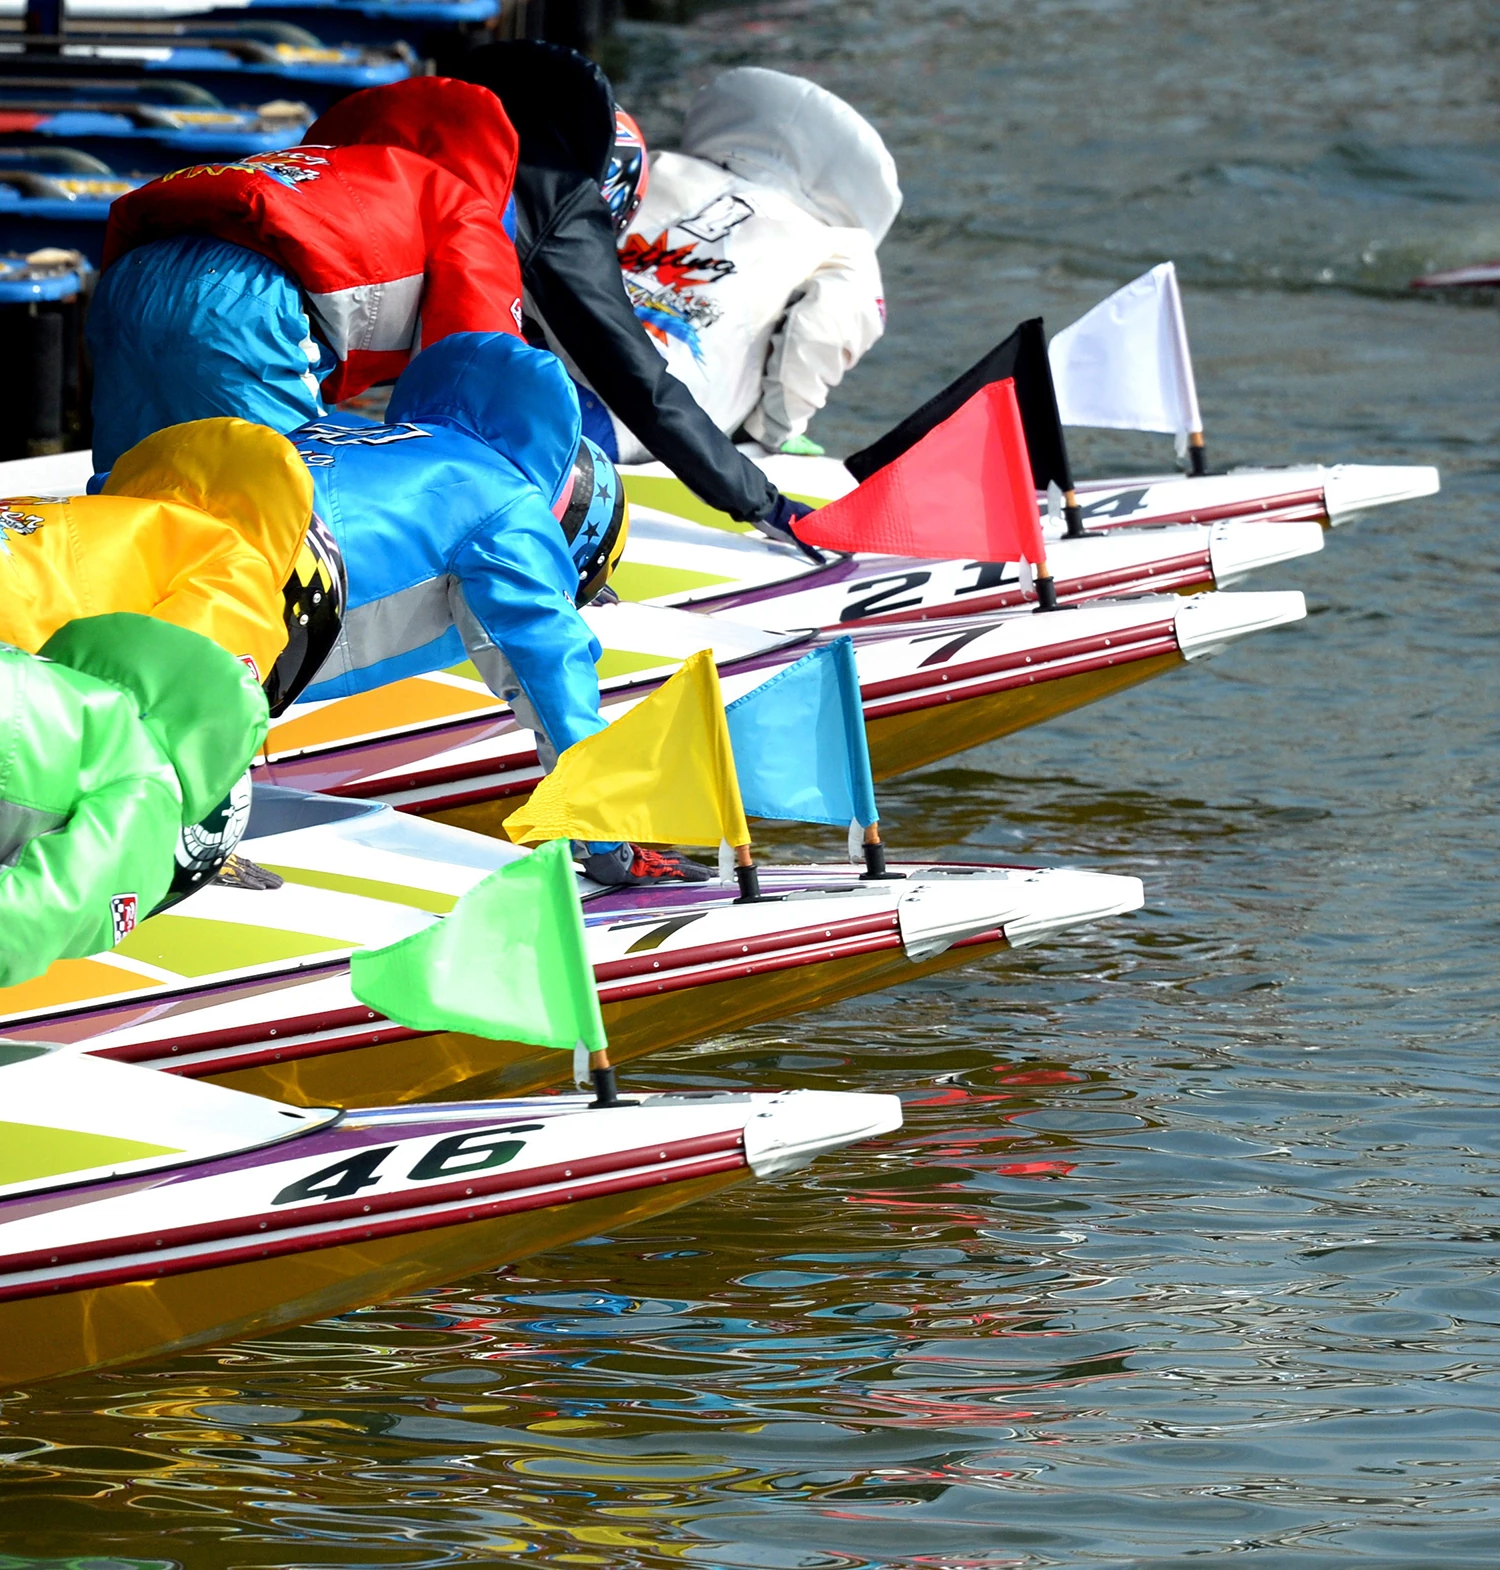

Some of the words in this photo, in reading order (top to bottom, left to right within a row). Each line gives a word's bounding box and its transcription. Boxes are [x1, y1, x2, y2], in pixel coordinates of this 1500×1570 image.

[1040, 488, 1150, 518] 4
[840, 561, 1020, 622] 21
[895, 623, 1004, 669] 7
[270, 1124, 545, 1206] 46
